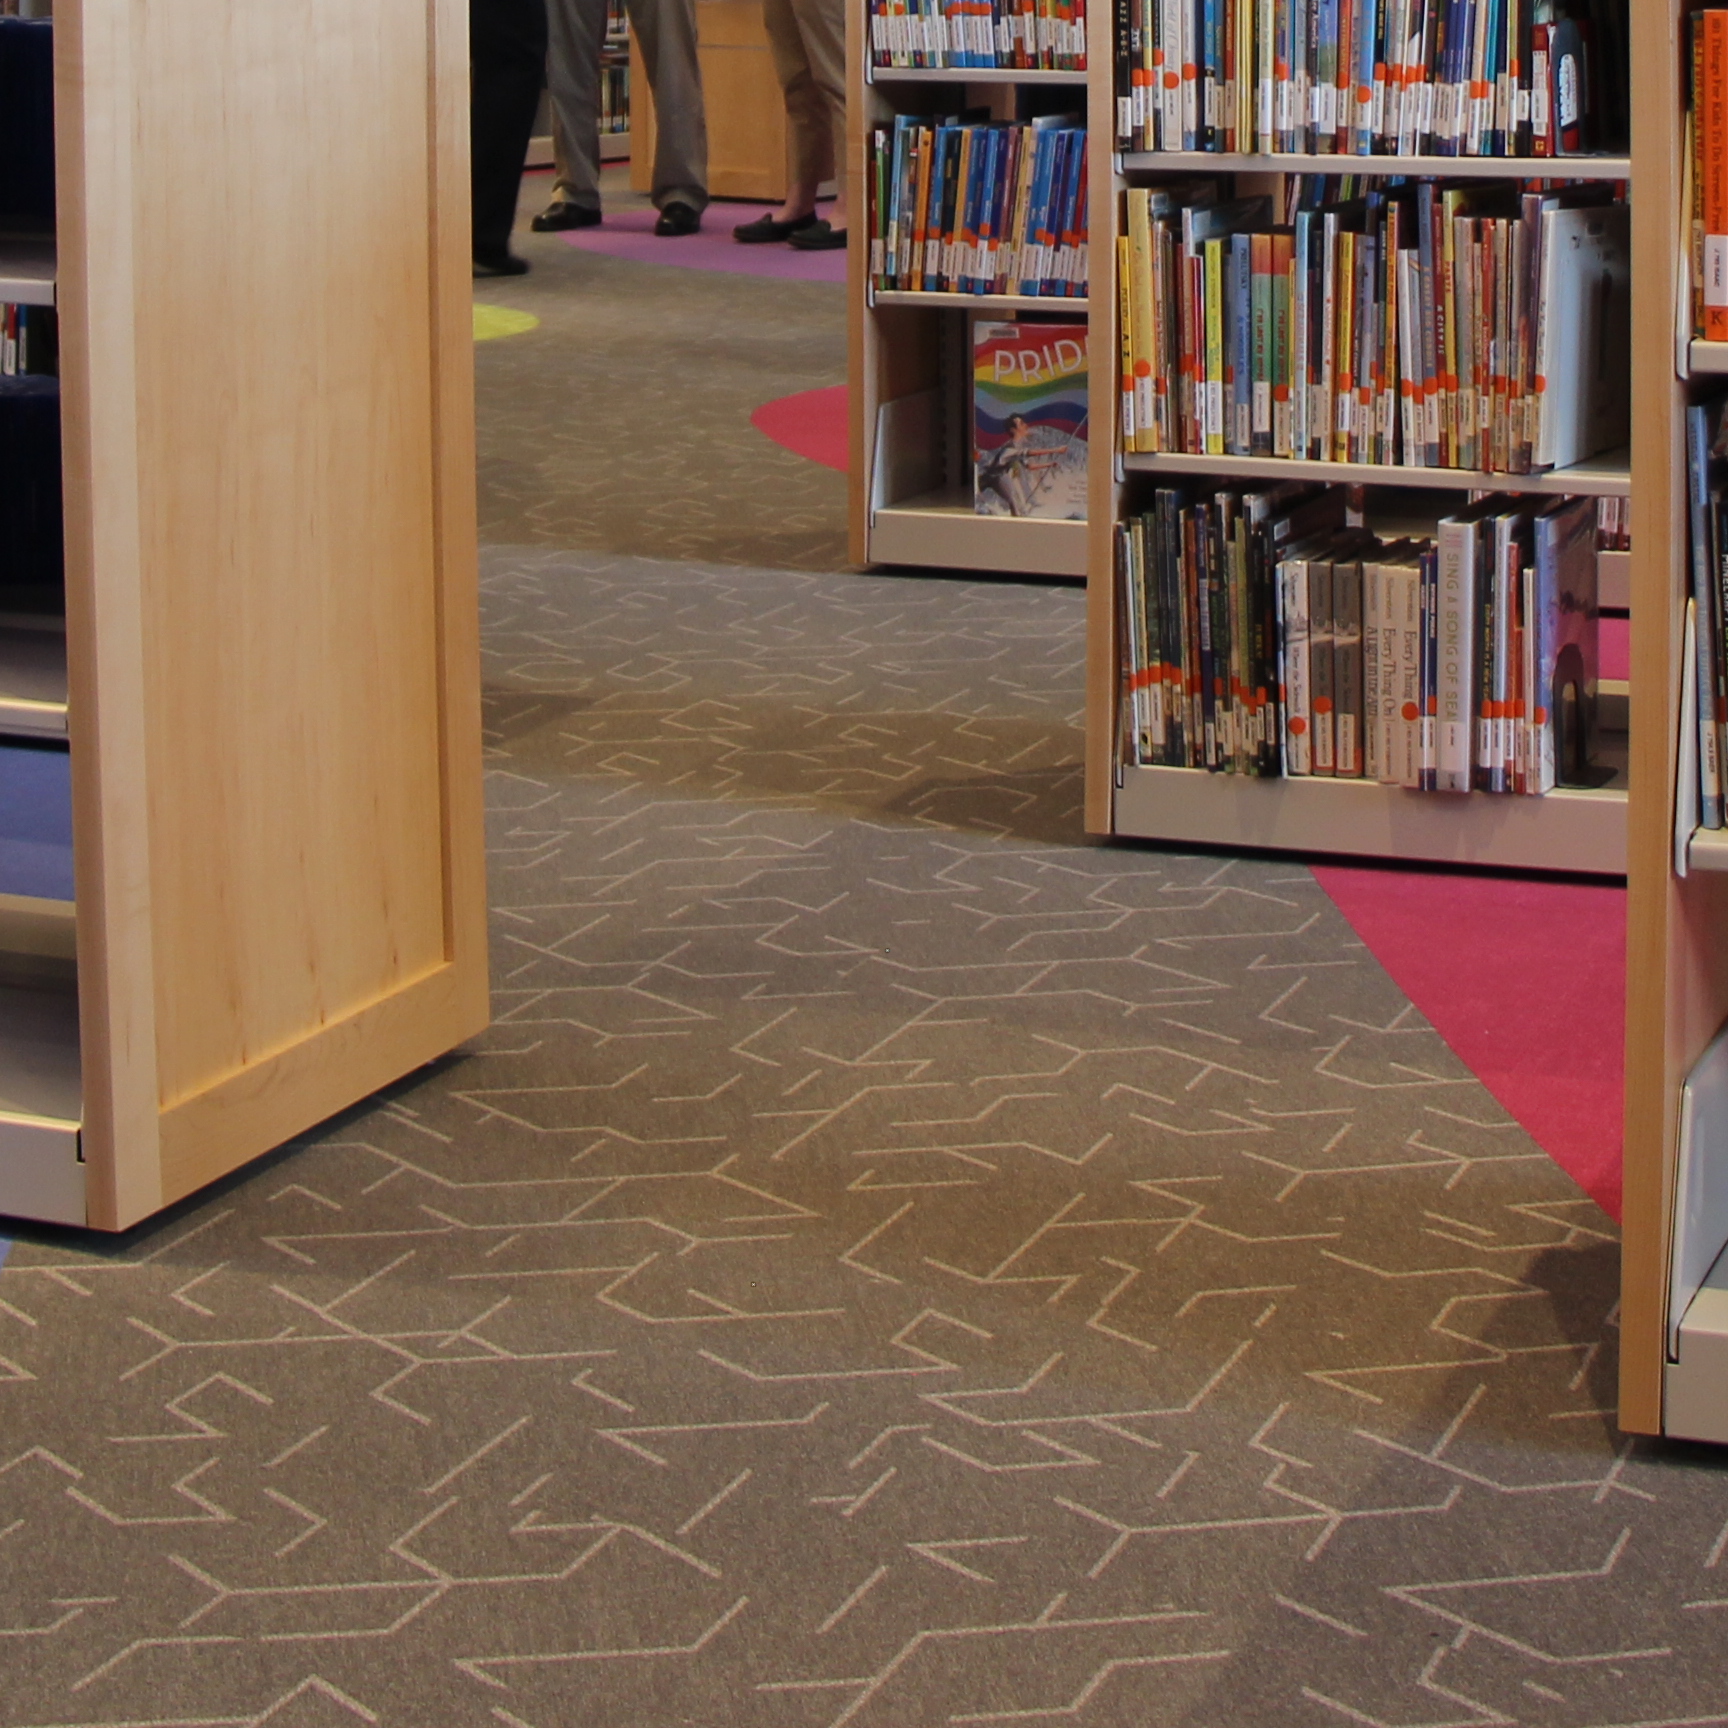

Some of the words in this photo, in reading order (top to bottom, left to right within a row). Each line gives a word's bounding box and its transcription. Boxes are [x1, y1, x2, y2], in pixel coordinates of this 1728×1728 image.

[993, 335, 1088, 384] PRID
[1445, 553, 1458, 590] SING
[1446, 595, 1457, 604] A
[1381, 627, 1396, 659] Every
[1403, 630, 1417, 661] Every
[1445, 610, 1458, 657] SONG
[1382, 661, 1395, 696] Thing
[1403, 663, 1417, 699] Thing
[1445, 662, 1457, 685] OF
[1385, 698, 1395, 715] On
